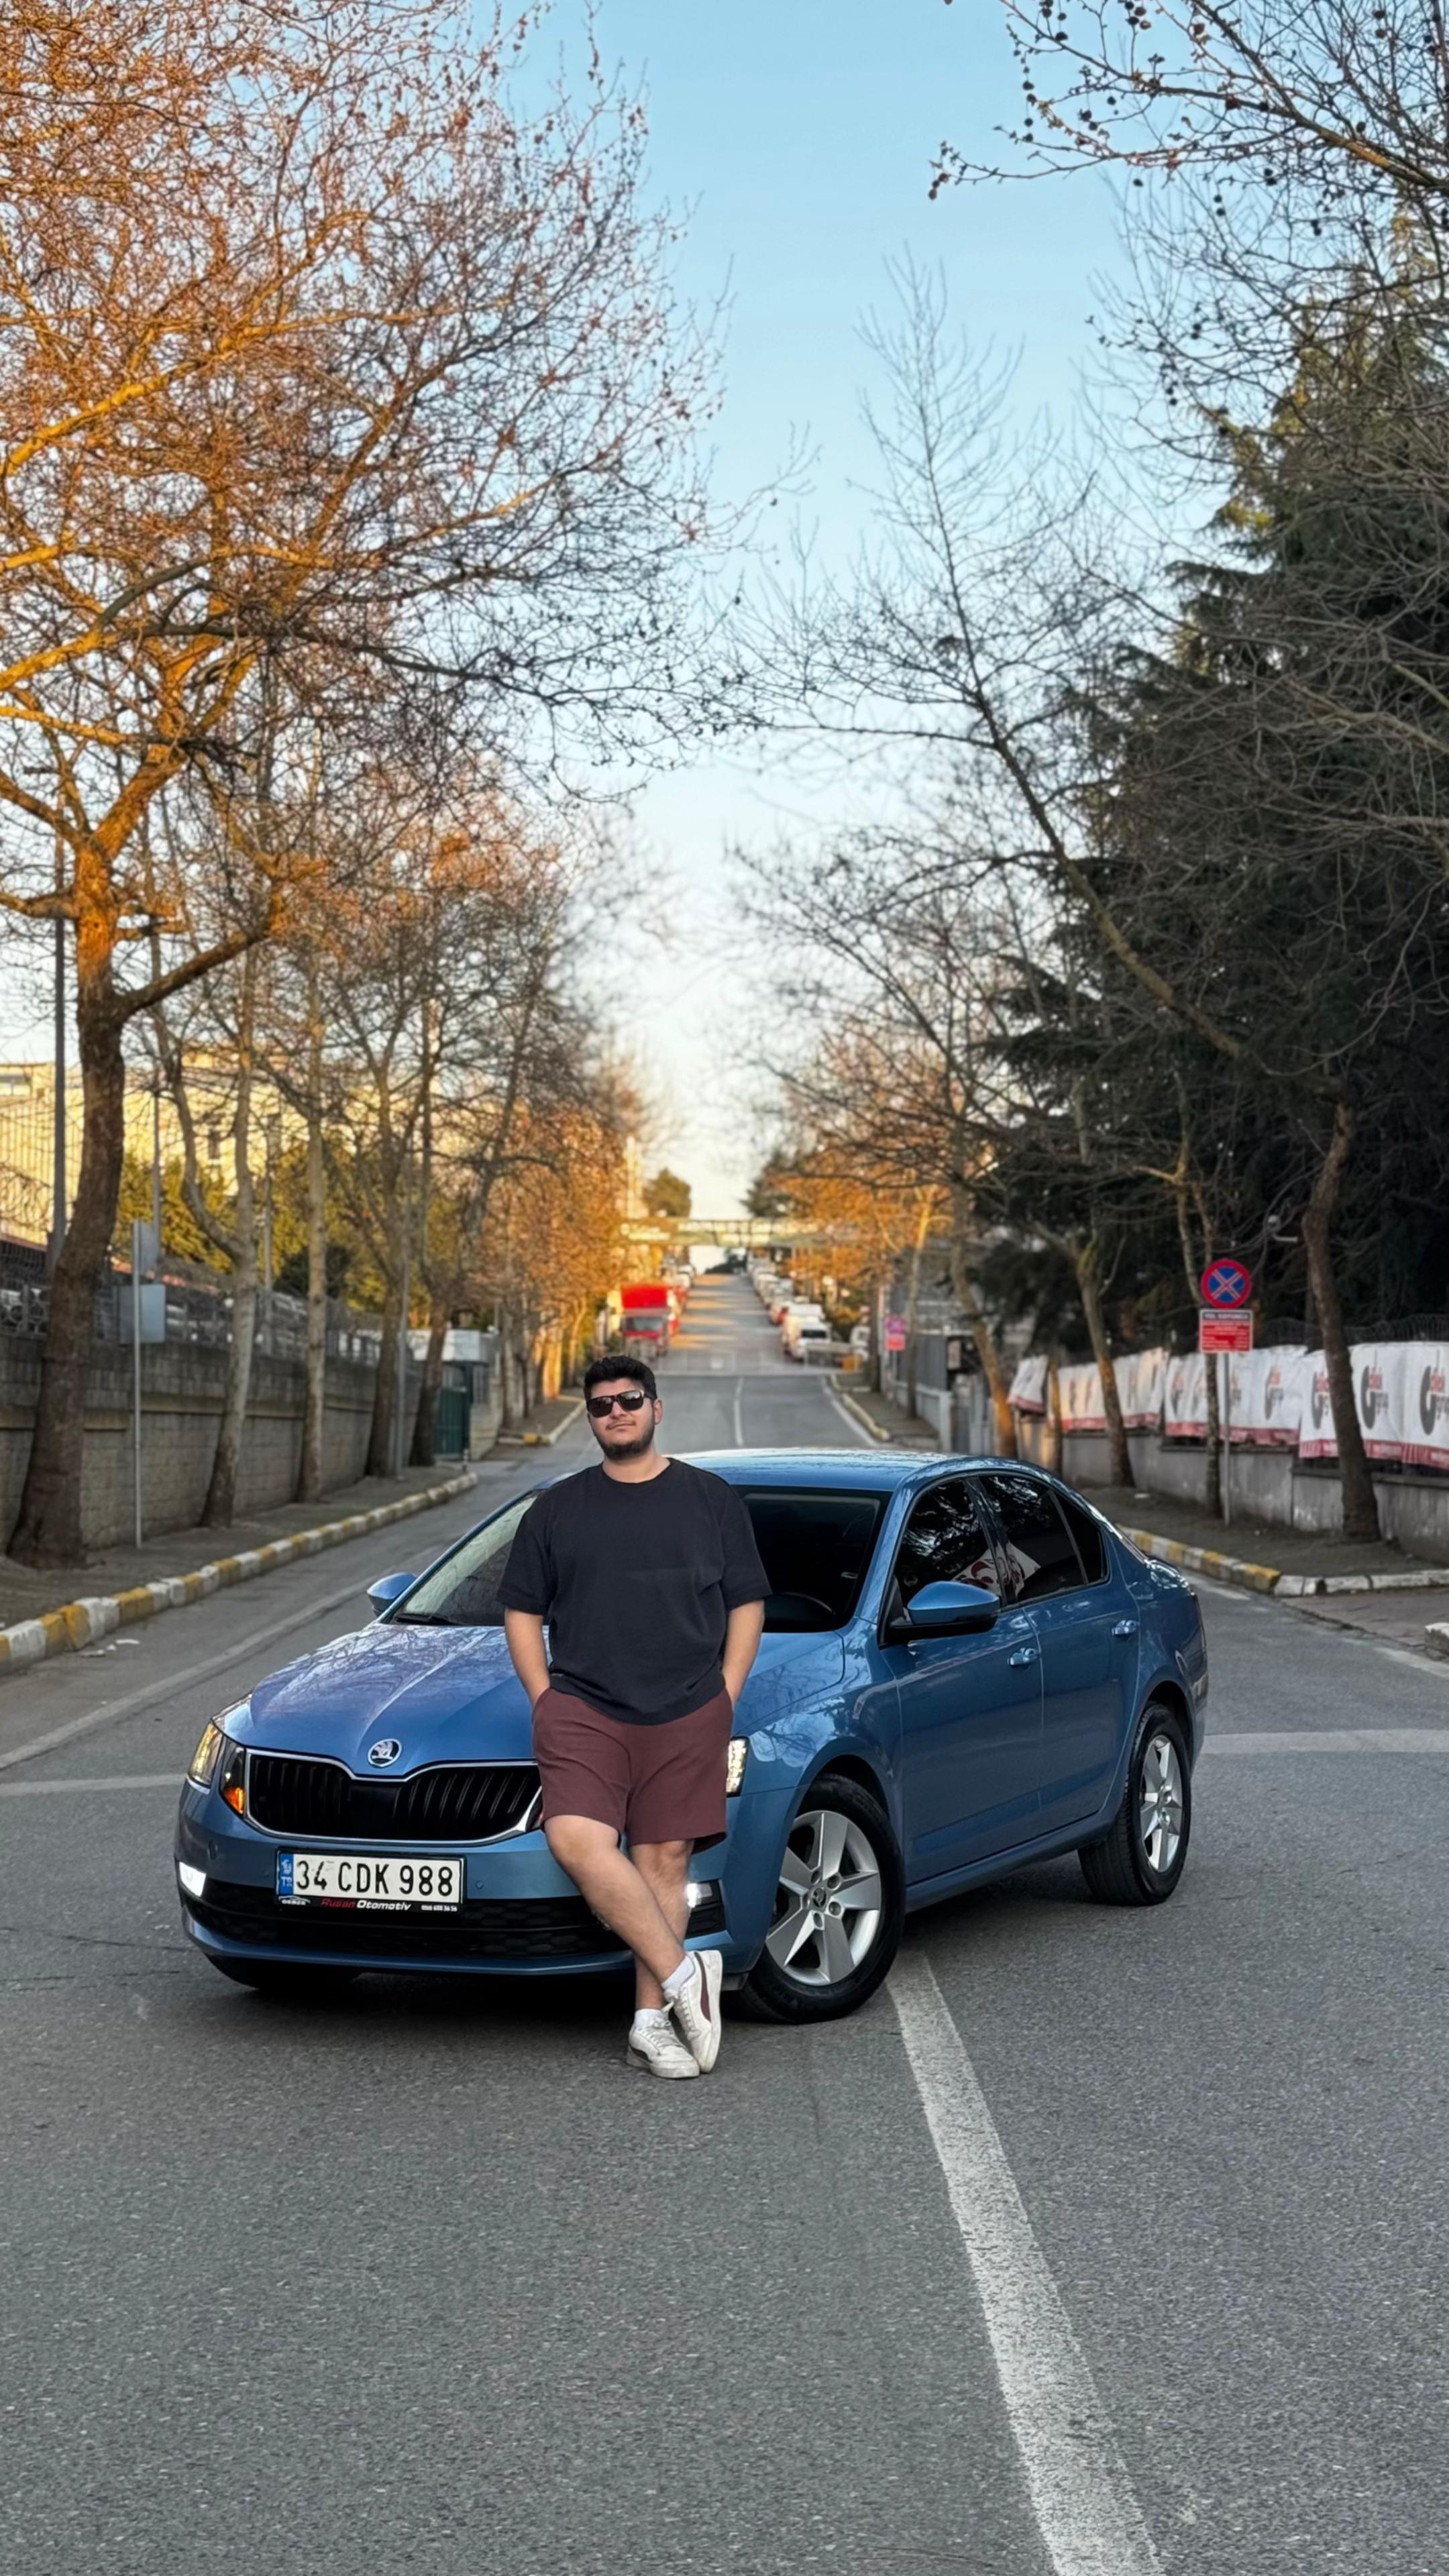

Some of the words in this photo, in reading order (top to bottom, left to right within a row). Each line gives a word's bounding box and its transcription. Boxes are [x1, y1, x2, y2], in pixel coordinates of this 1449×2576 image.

[296, 1860, 327, 1890] 34
[338, 1862, 389, 1894] CDK
[399, 1865, 453, 1896] 988
